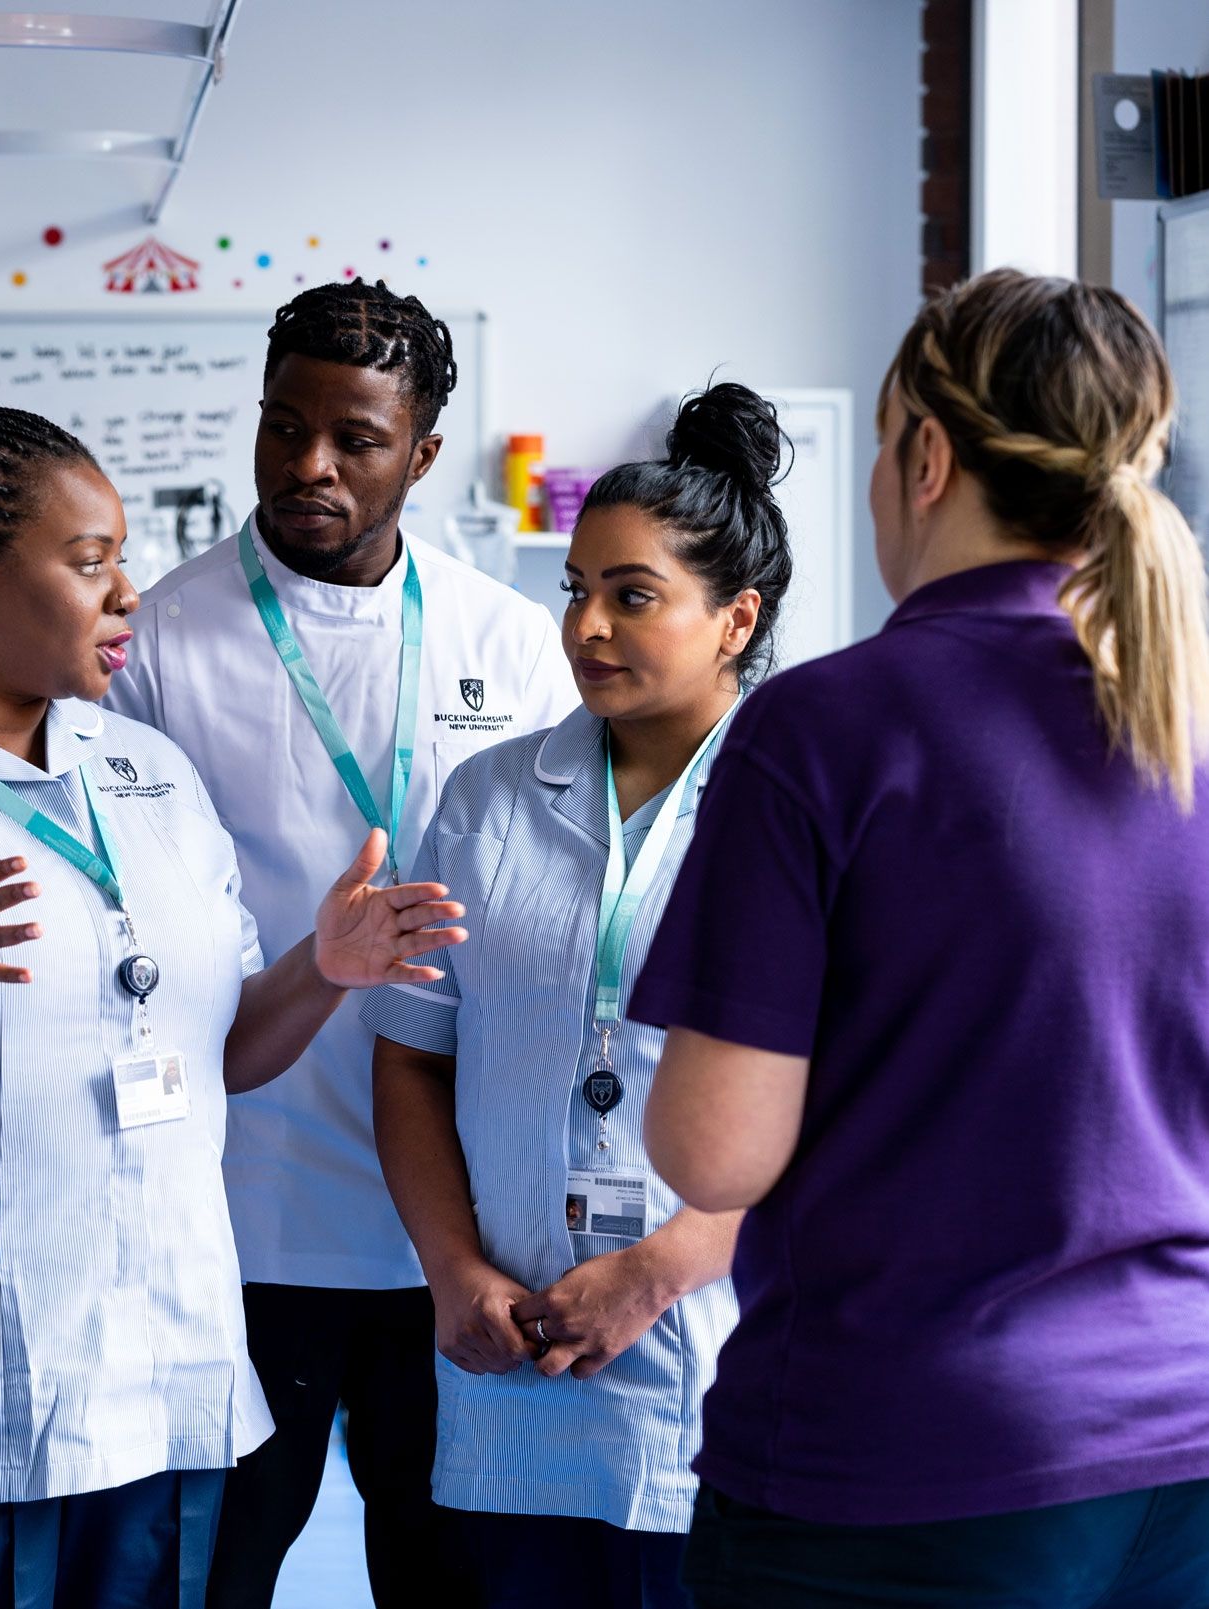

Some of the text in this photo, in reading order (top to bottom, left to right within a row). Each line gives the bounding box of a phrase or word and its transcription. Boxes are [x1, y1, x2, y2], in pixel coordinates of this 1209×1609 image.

[434, 713, 514, 723] BUCKINGHAMSHIRE
[449, 723, 505, 731] NEW UNIVERSITY
[97, 782, 177, 793] BUCKINGHAMSHIRE
